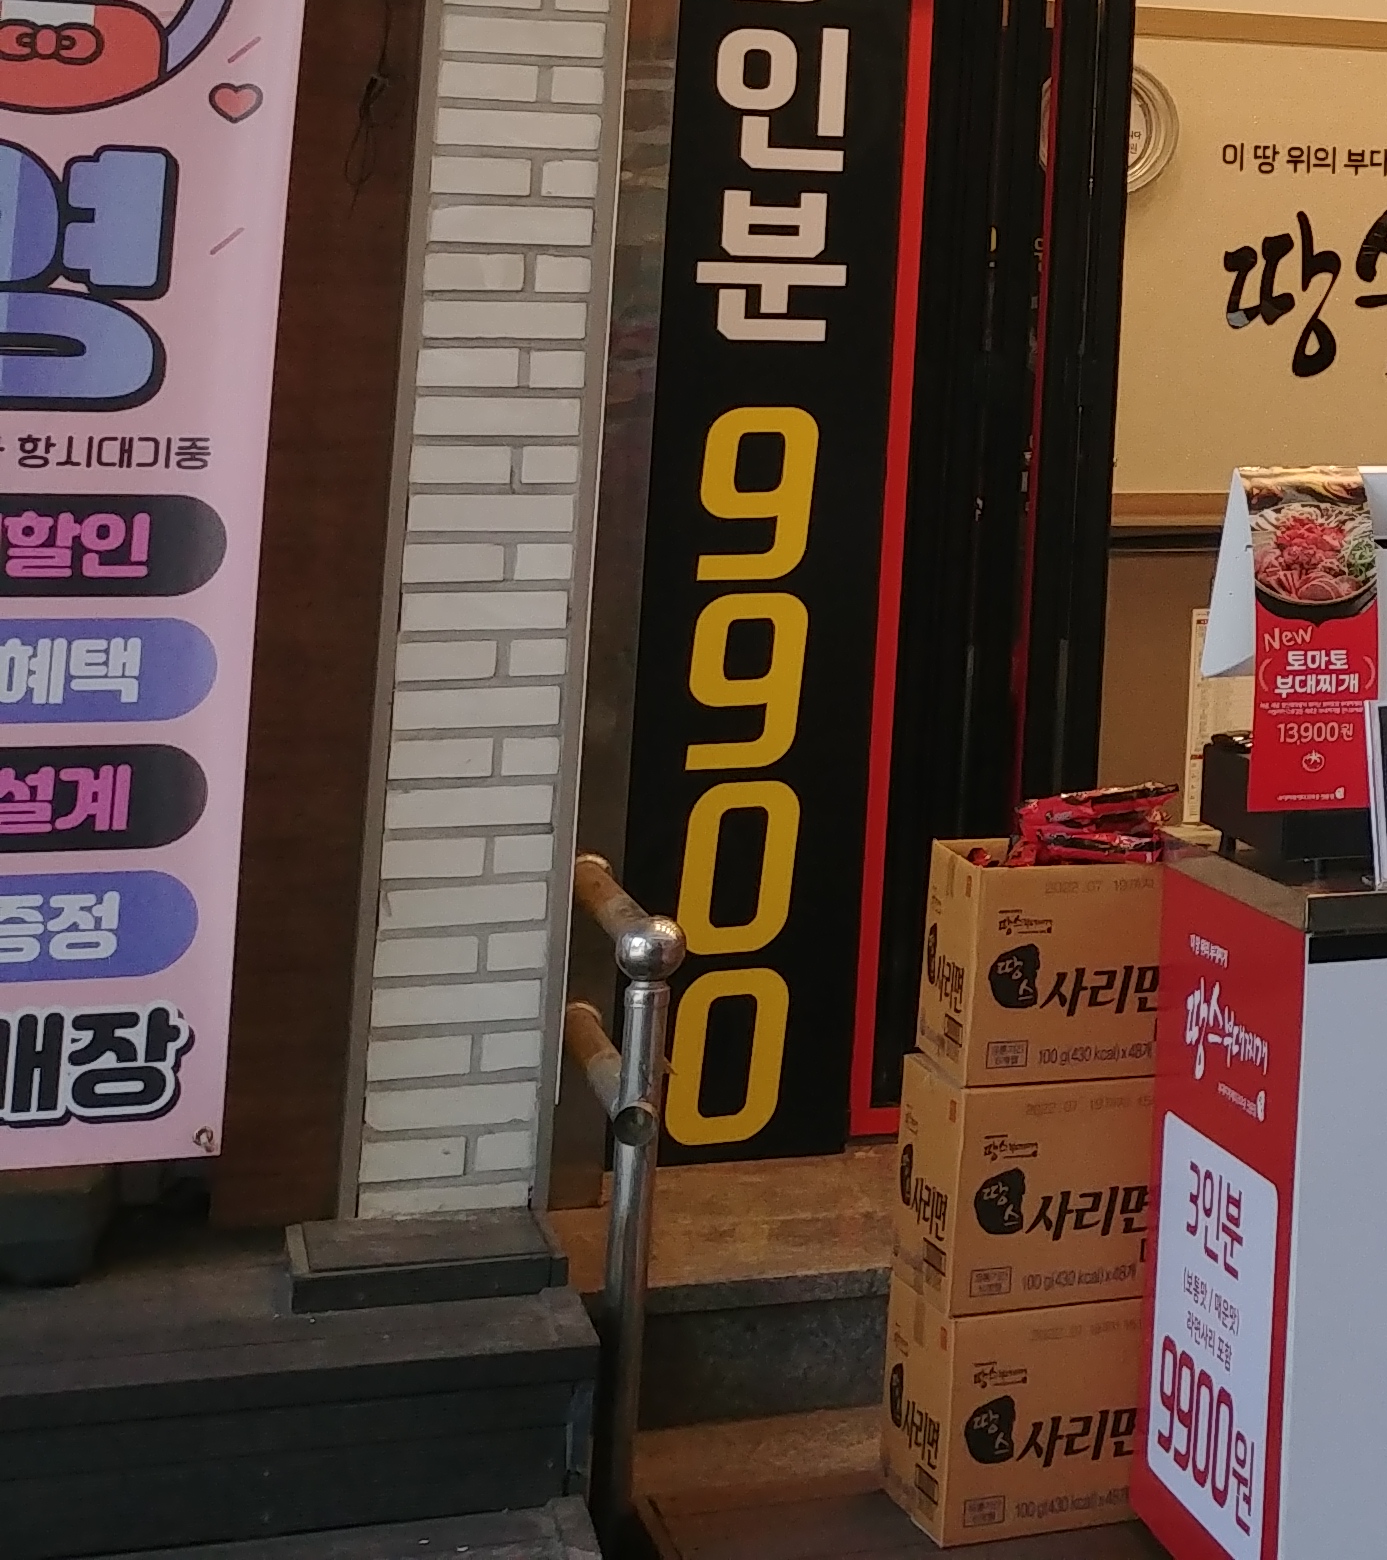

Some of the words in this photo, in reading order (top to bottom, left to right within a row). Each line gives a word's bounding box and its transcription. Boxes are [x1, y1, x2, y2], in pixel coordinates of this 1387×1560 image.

[1221, 143, 1245, 172] 이
[1253, 144, 1280, 174] 땅
[1285, 146, 1338, 175] 위의
[1263, 625, 1313, 652] New
[1285, 649, 1349, 671] 토마토
[1273, 672, 1359, 699] 부대찌개
[663, 405, 823, 1149] 9900
[1186, 1158, 1246, 1281] 3인분
